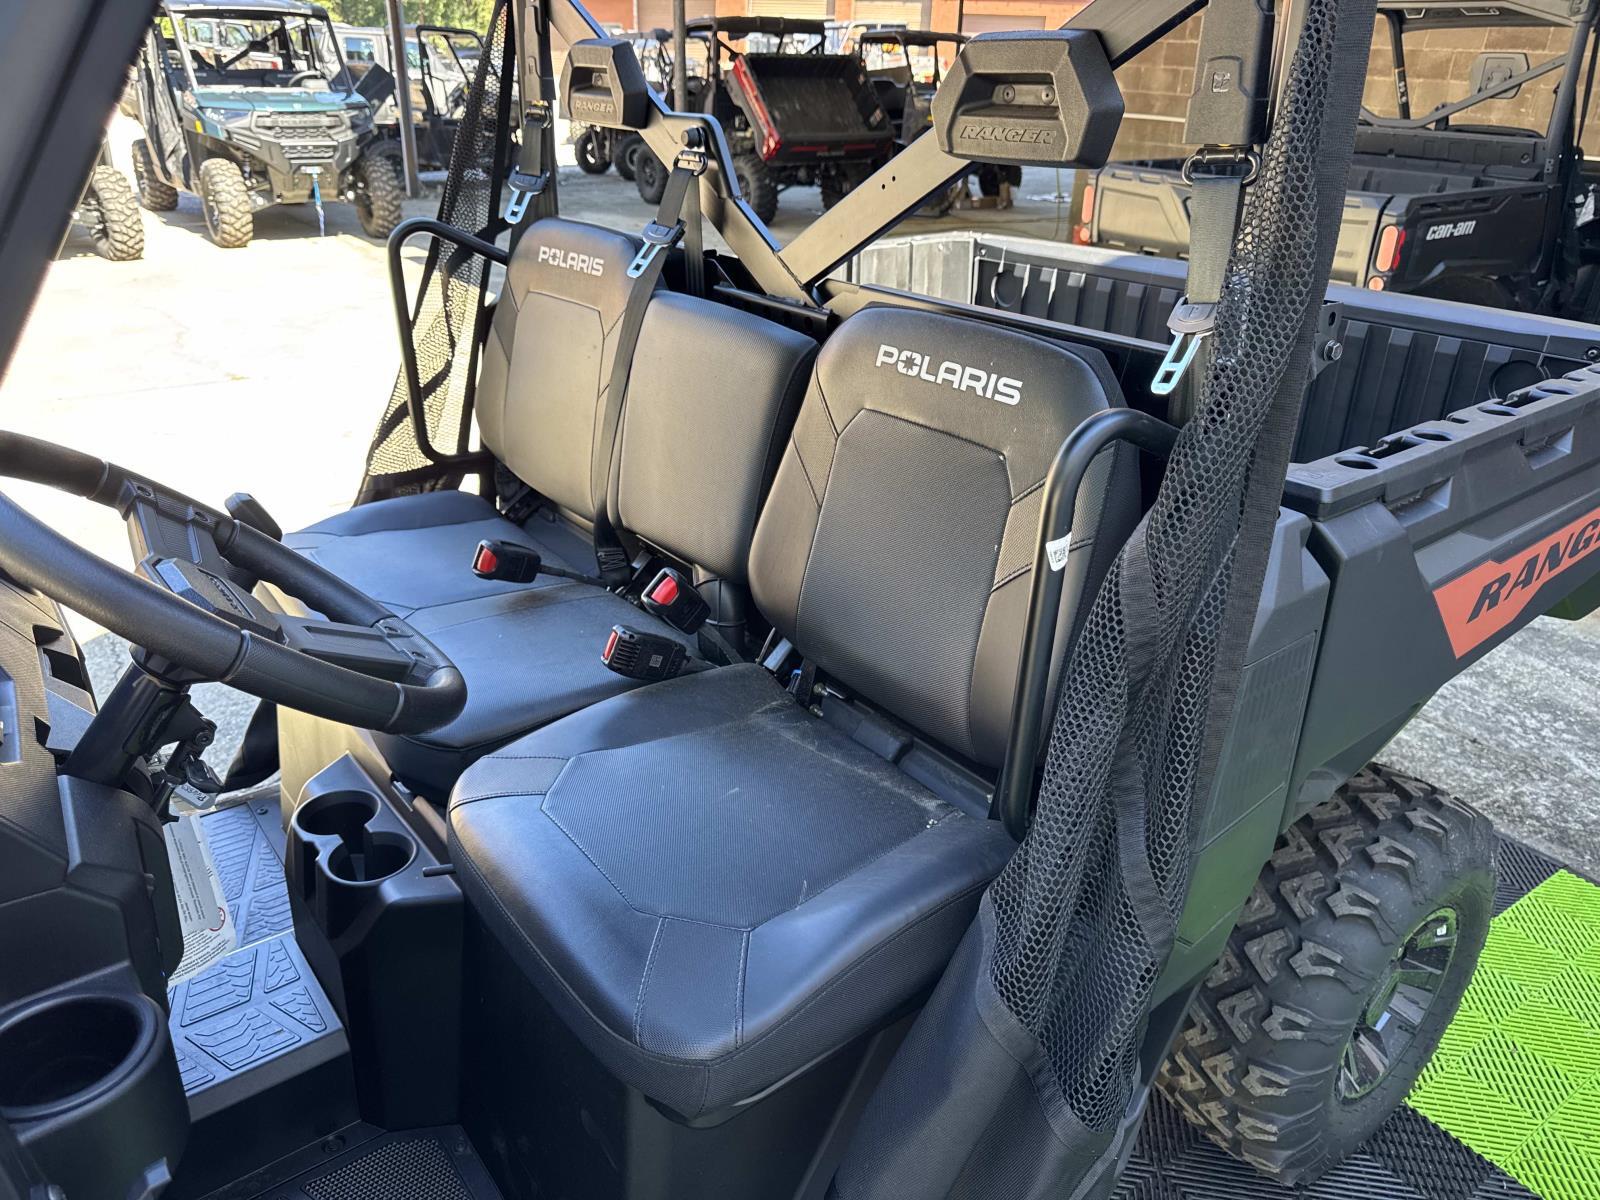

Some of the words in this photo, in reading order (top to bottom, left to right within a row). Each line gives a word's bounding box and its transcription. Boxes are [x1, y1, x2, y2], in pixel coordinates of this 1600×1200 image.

[575, 100, 614, 113] RANGER
[960, 125, 1057, 144] RANGER
[1426, 220, 1476, 241] can-am
[538, 246, 604, 277] POLARIS
[875, 344, 1023, 406] POLARIS
[1466, 518, 1600, 625] RANG
